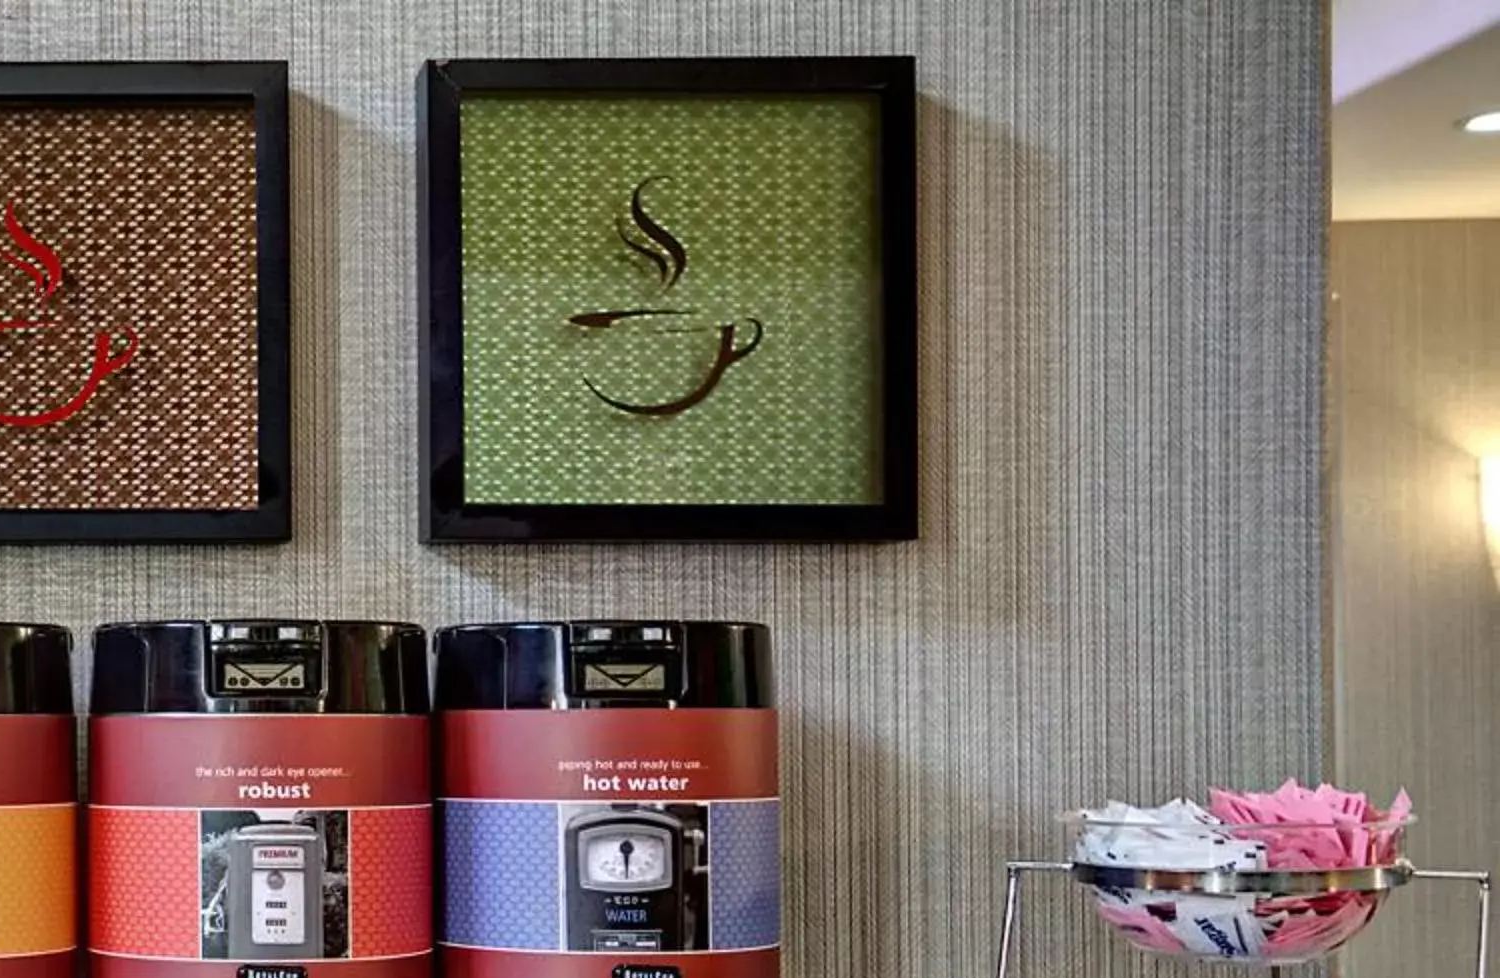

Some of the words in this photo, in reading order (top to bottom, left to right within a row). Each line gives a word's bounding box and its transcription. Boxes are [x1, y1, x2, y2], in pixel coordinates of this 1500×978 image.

[195, 766, 212, 777] the
[215, 766, 234, 777] rich
[237, 766, 258, 777] and
[260, 765, 284, 777] dark
[287, 767, 305, 779] eye
[595, 759, 613, 770] hot
[616, 759, 637, 770] and
[640, 759, 669, 772] ready
[671, 759, 682, 769] to
[583, 774, 621, 791] hot
[627, 774, 690, 791] water
[238, 781, 312, 799] robust
[605, 909, 647, 922] WATER
